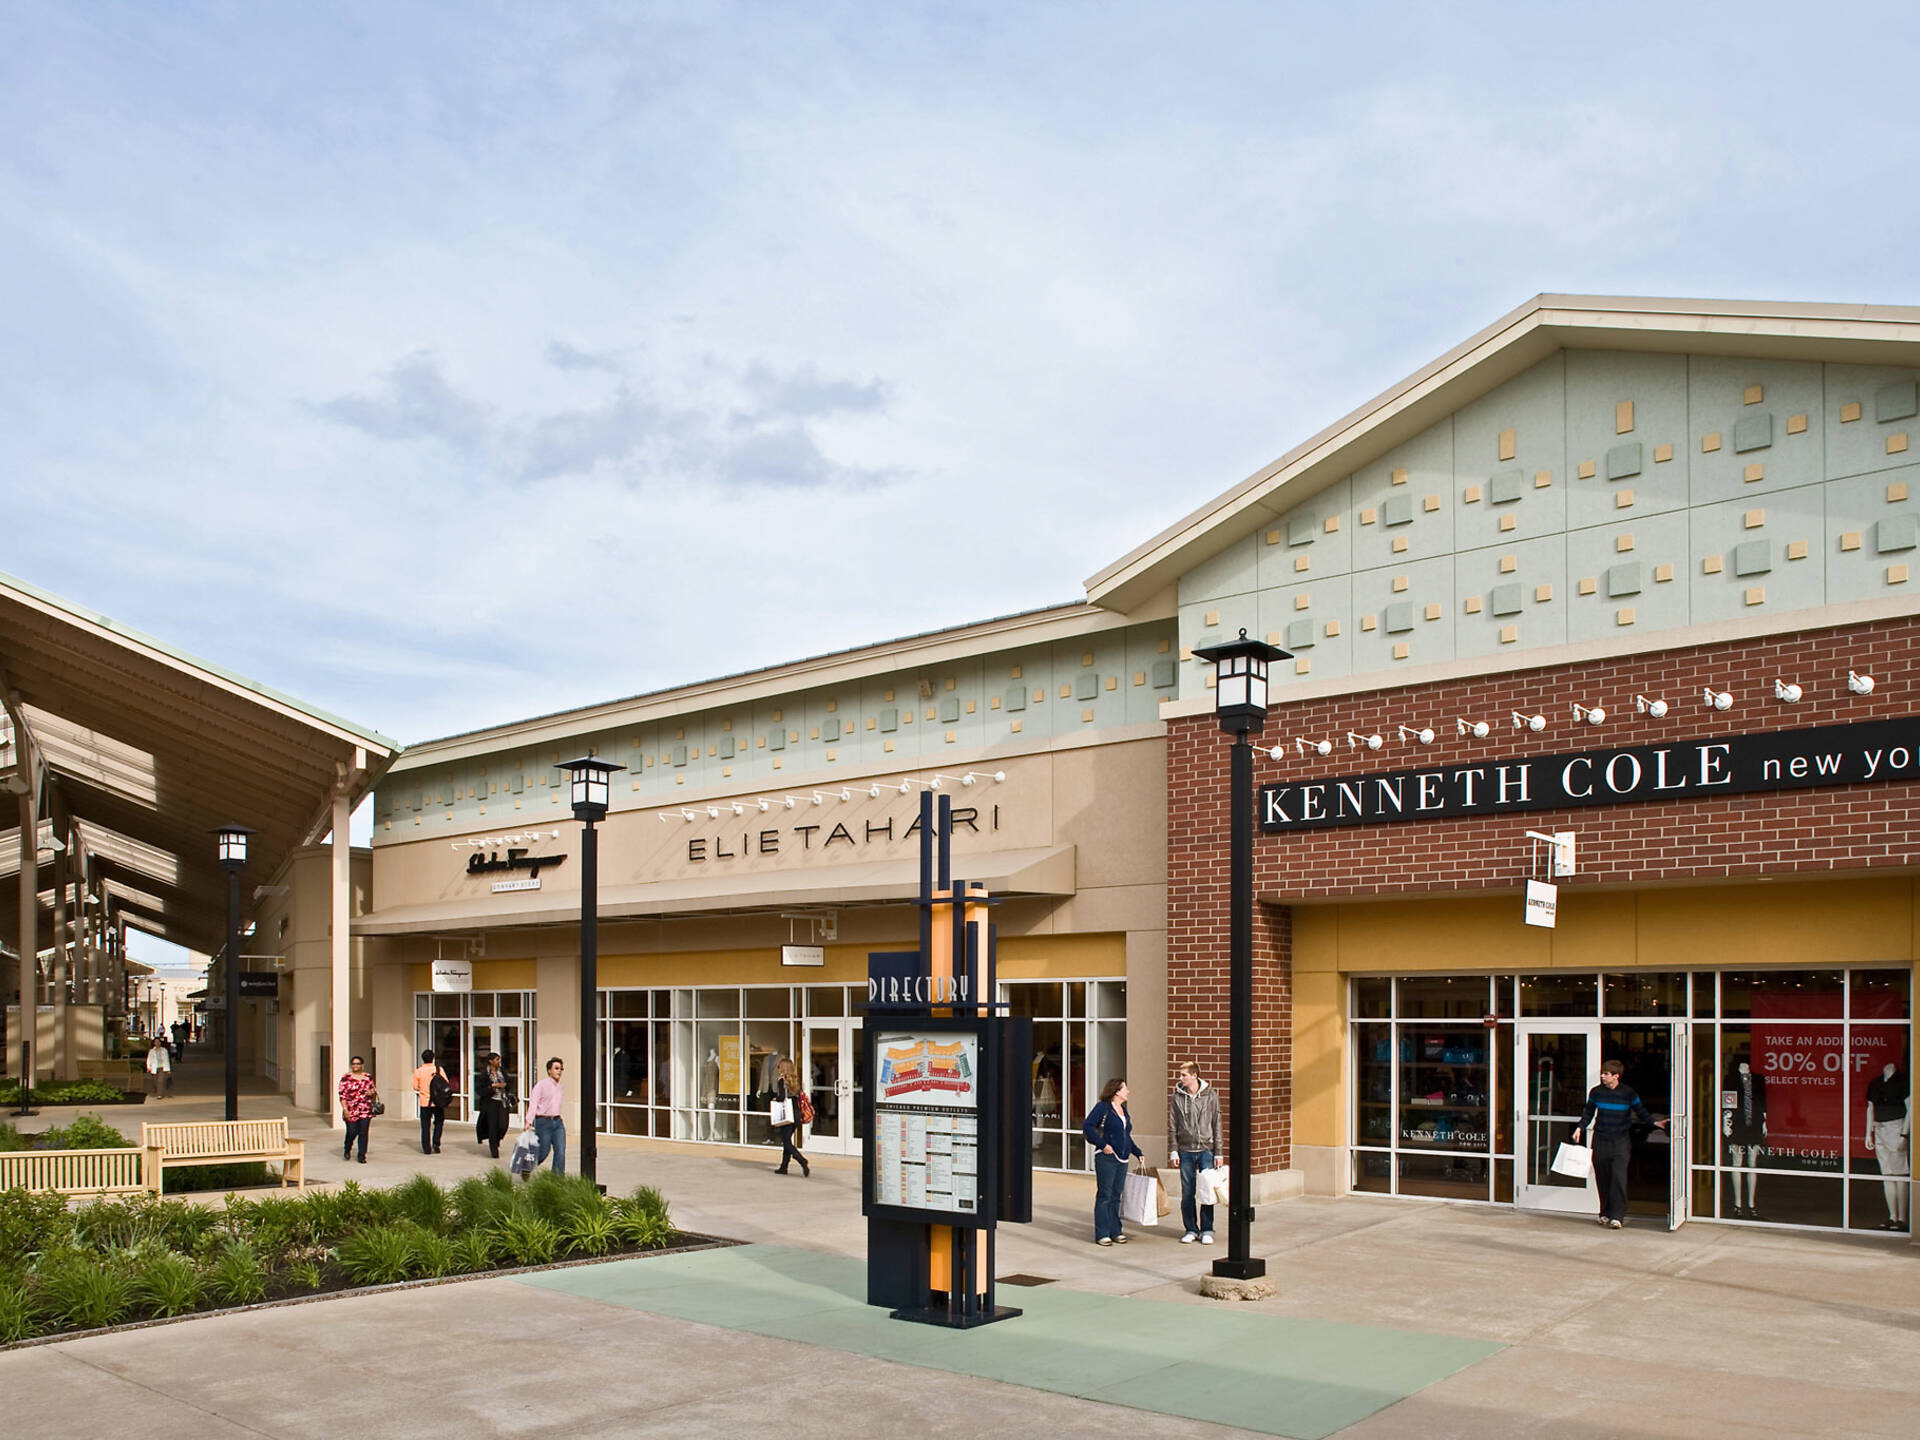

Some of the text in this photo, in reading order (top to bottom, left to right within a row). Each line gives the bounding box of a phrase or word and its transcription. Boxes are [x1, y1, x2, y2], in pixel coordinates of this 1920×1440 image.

[1263, 744, 1920, 824] KENNETH COLE new yo
[688, 804, 1000, 861] ELIE TAHARI
[868, 975, 968, 1002] DIRECTORY
[1764, 1036, 1887, 1047] TAKE AN ADDIIONAL
[1763, 1052, 1817, 1072] 30%
[1764, 1076, 1836, 1086] SELECT STYLES
[1402, 1129, 1487, 1142] KENNETH COLE
[1728, 1144, 1838, 1160] KENNETH COLE
